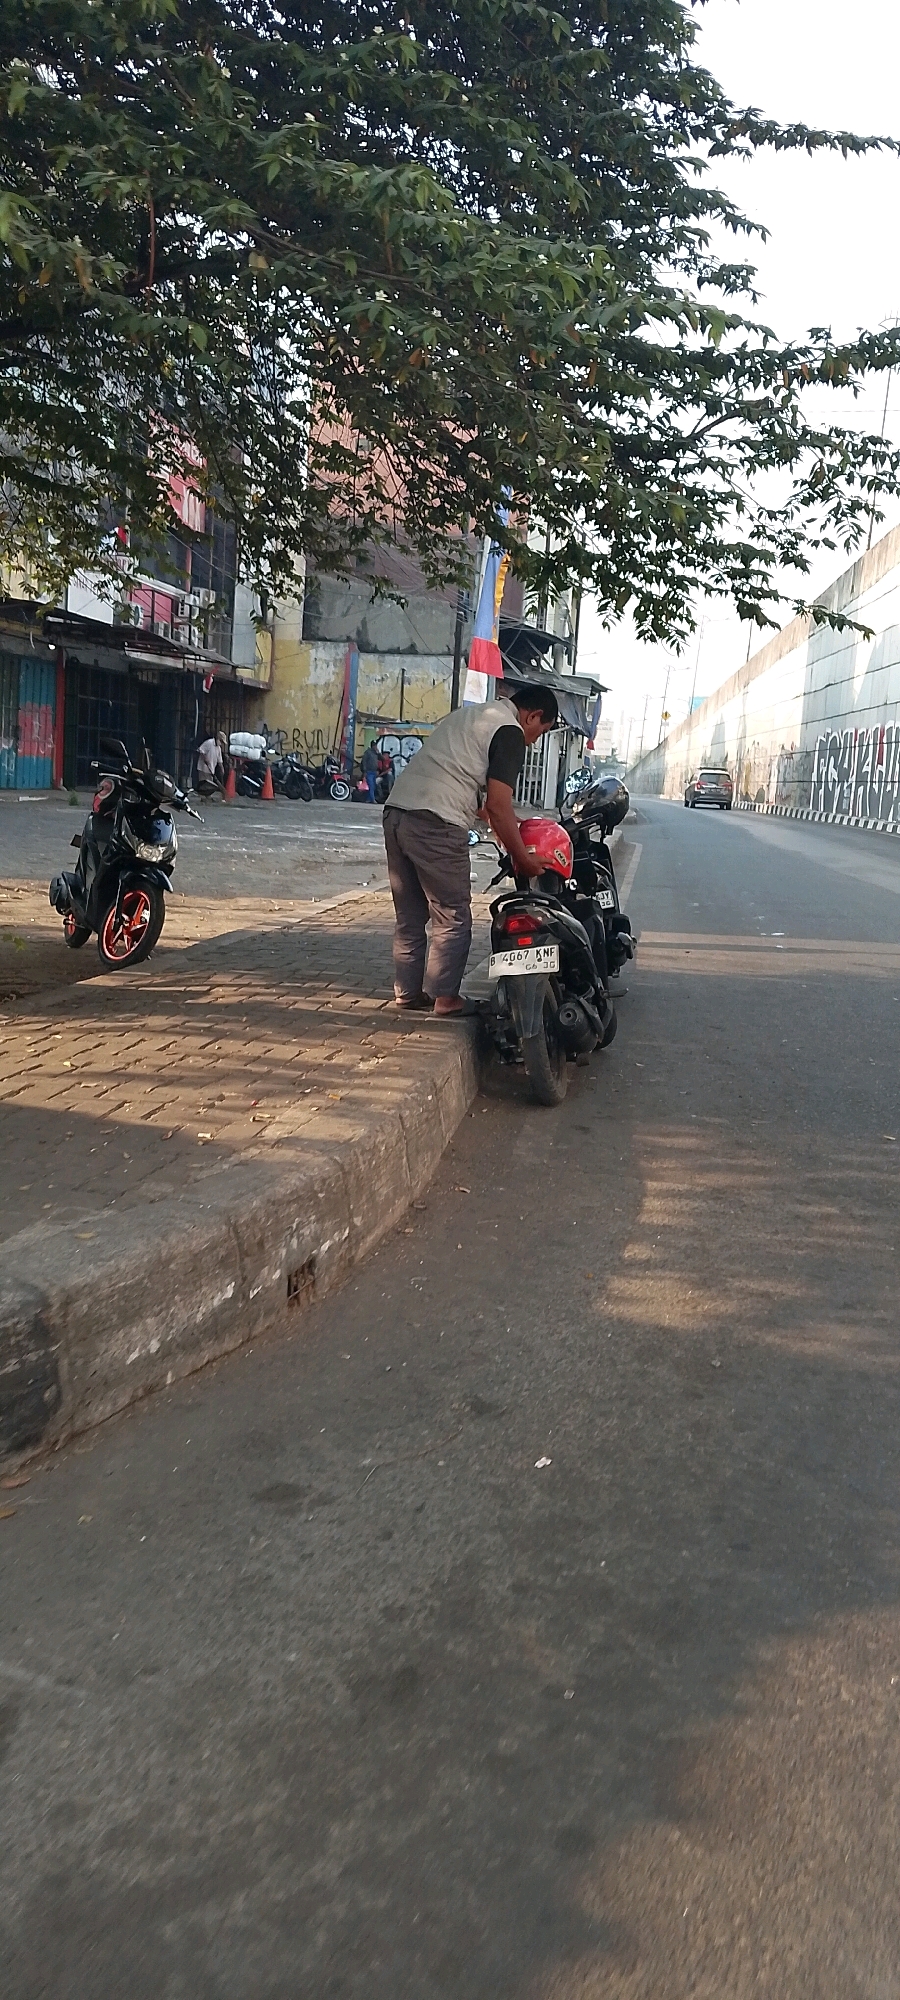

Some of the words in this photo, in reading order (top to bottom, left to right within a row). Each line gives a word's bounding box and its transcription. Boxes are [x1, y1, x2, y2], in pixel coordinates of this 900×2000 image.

[490, 957, 496, 966] B
[502, 950, 530, 962] 4067
[535, 947, 556, 959] KNF
